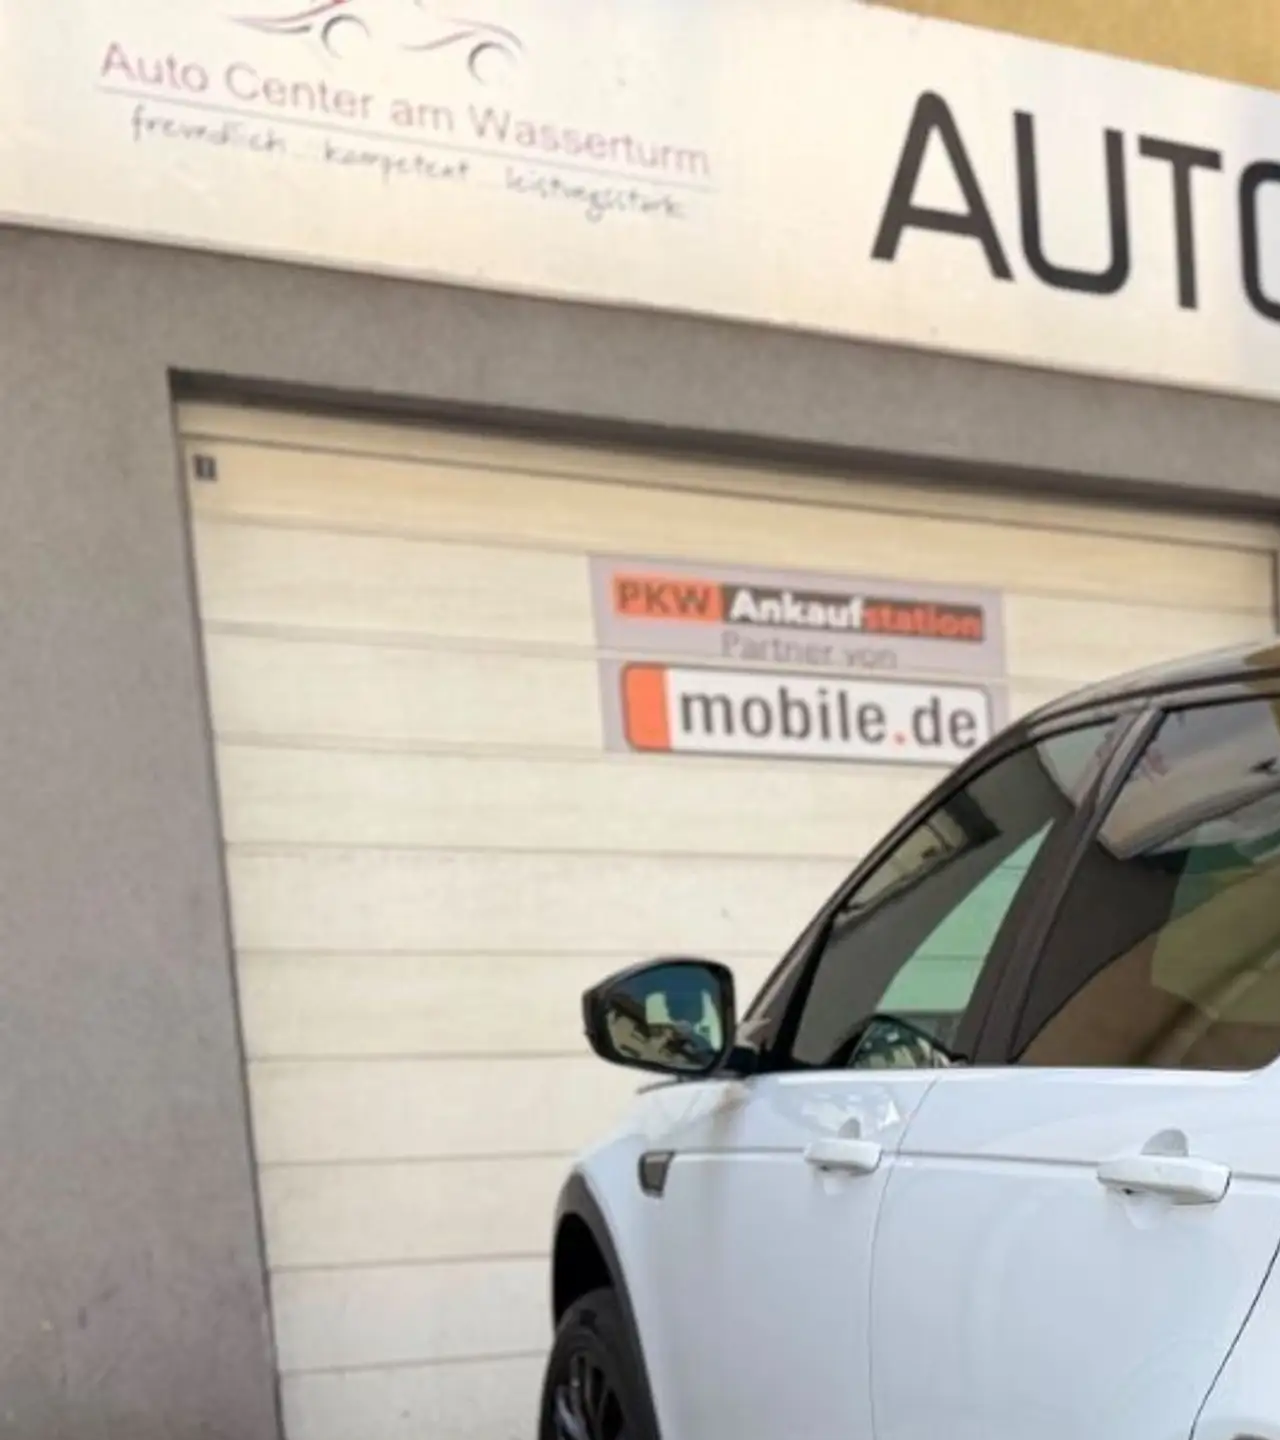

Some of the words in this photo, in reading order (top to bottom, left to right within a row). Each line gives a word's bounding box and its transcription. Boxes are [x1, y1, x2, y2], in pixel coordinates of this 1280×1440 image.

[100, 41, 209, 93] Auto
[225, 61, 376, 120] Center
[390, 98, 455, 132] am
[469, 103, 711, 176] Wasserturm
[615, 579, 713, 617] PKW
[721, 630, 834, 666] Partner
[843, 647, 899, 669] von
[679, 685, 979, 749] mobile.de
